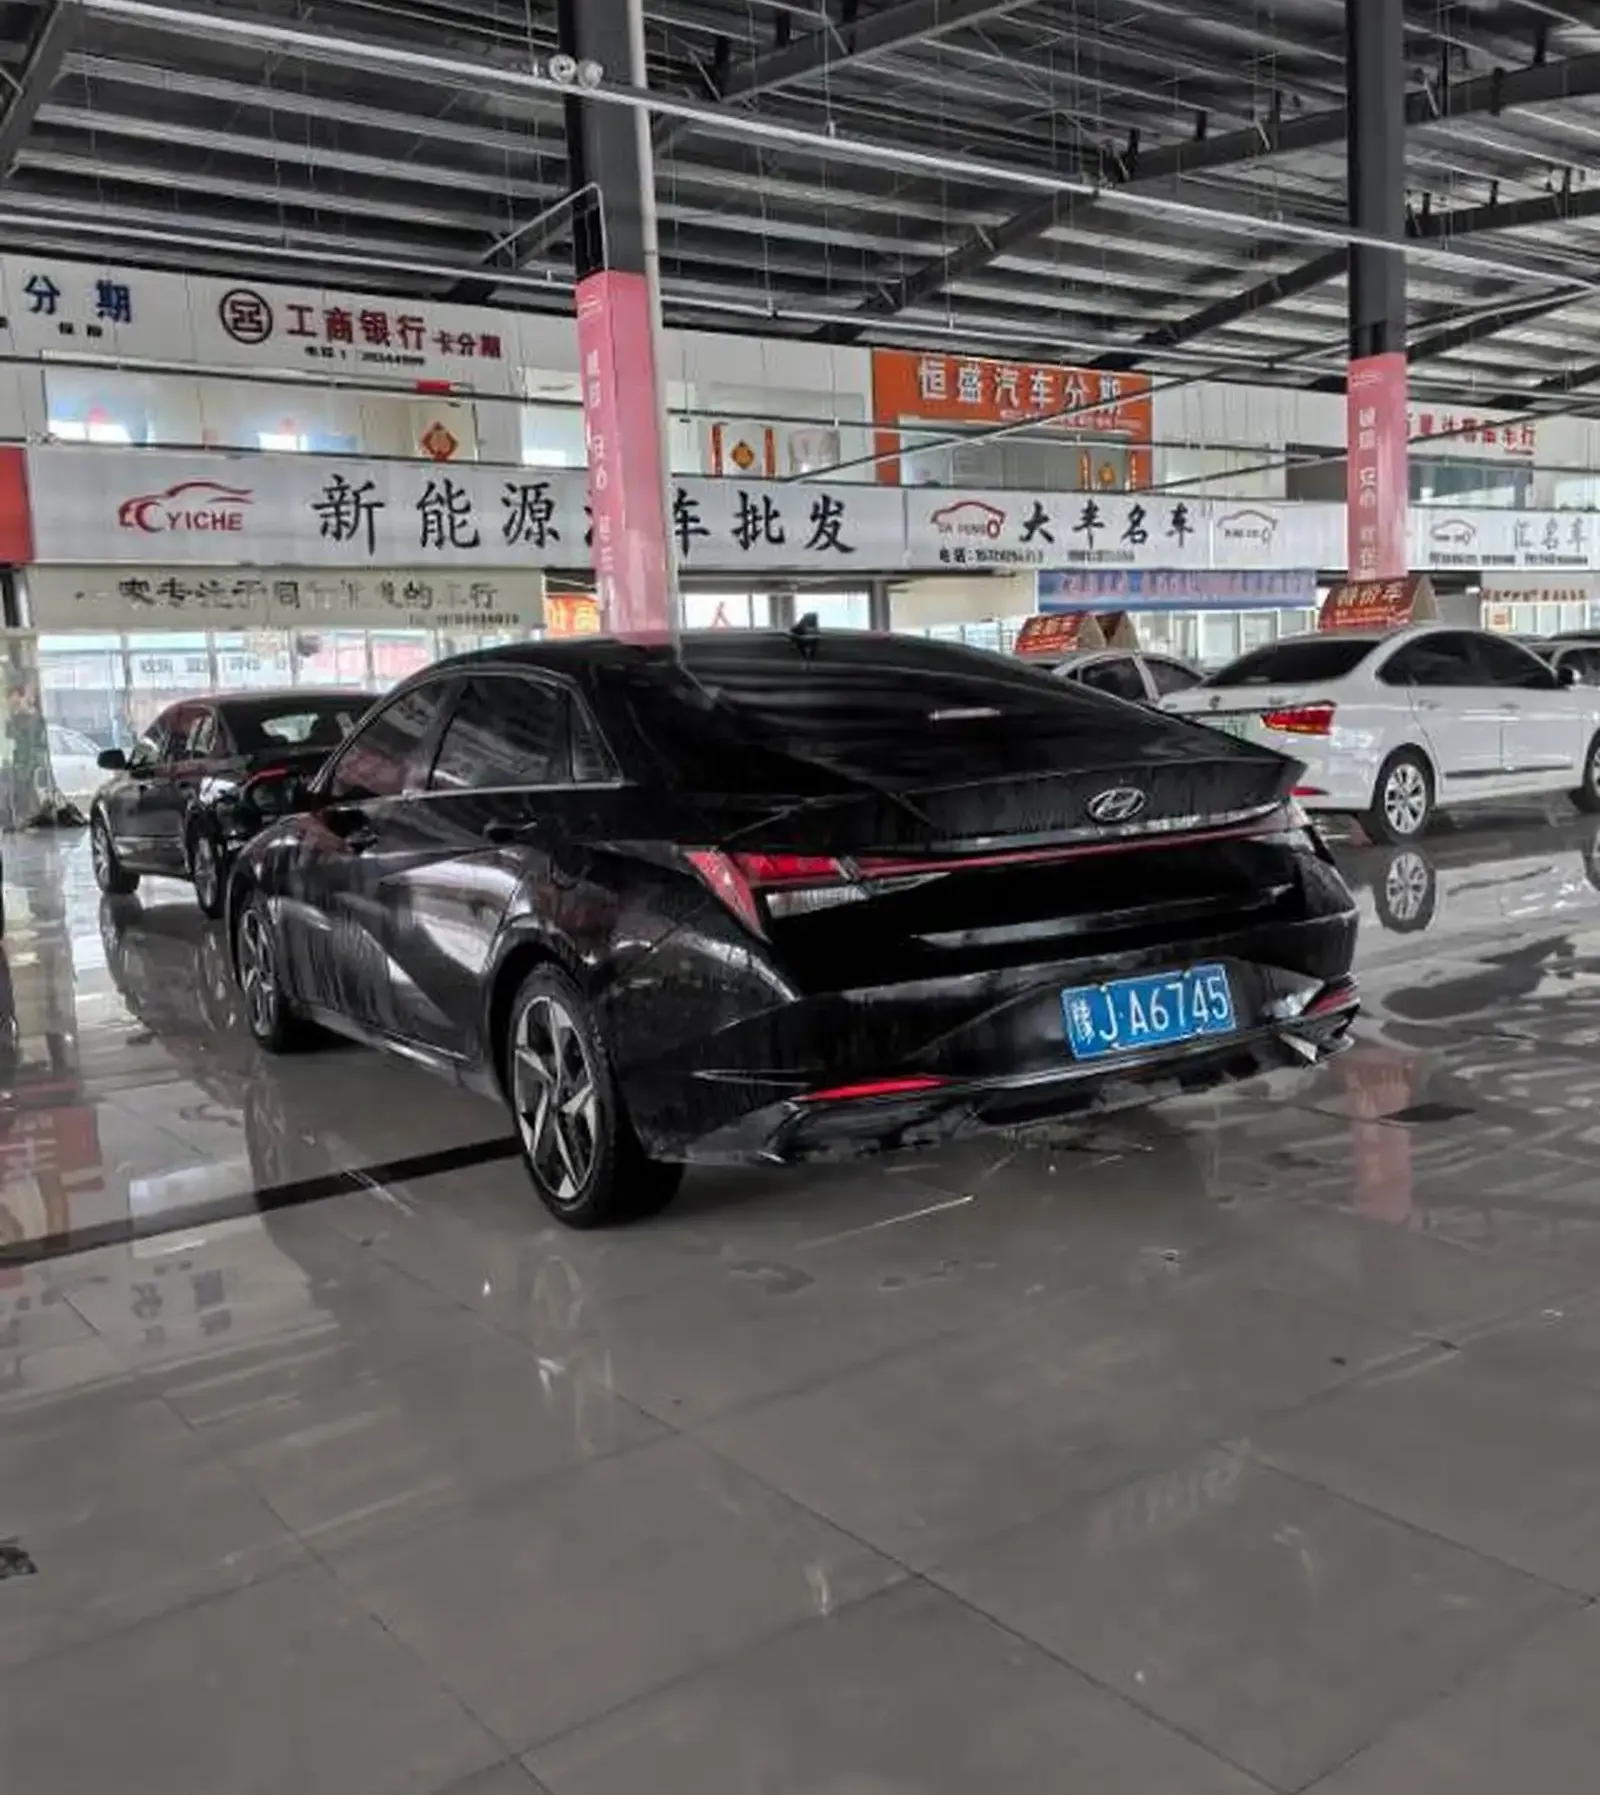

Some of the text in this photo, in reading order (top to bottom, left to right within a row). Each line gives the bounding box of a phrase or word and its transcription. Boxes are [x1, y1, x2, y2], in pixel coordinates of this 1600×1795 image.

[24, 275, 132, 324] 分期
[286, 304, 427, 351] 工商银行
[167, 511, 243, 531] YICHE
[313, 474, 857, 557] 新能源车批发
[1018, 499, 1195, 551] 大丰名车
